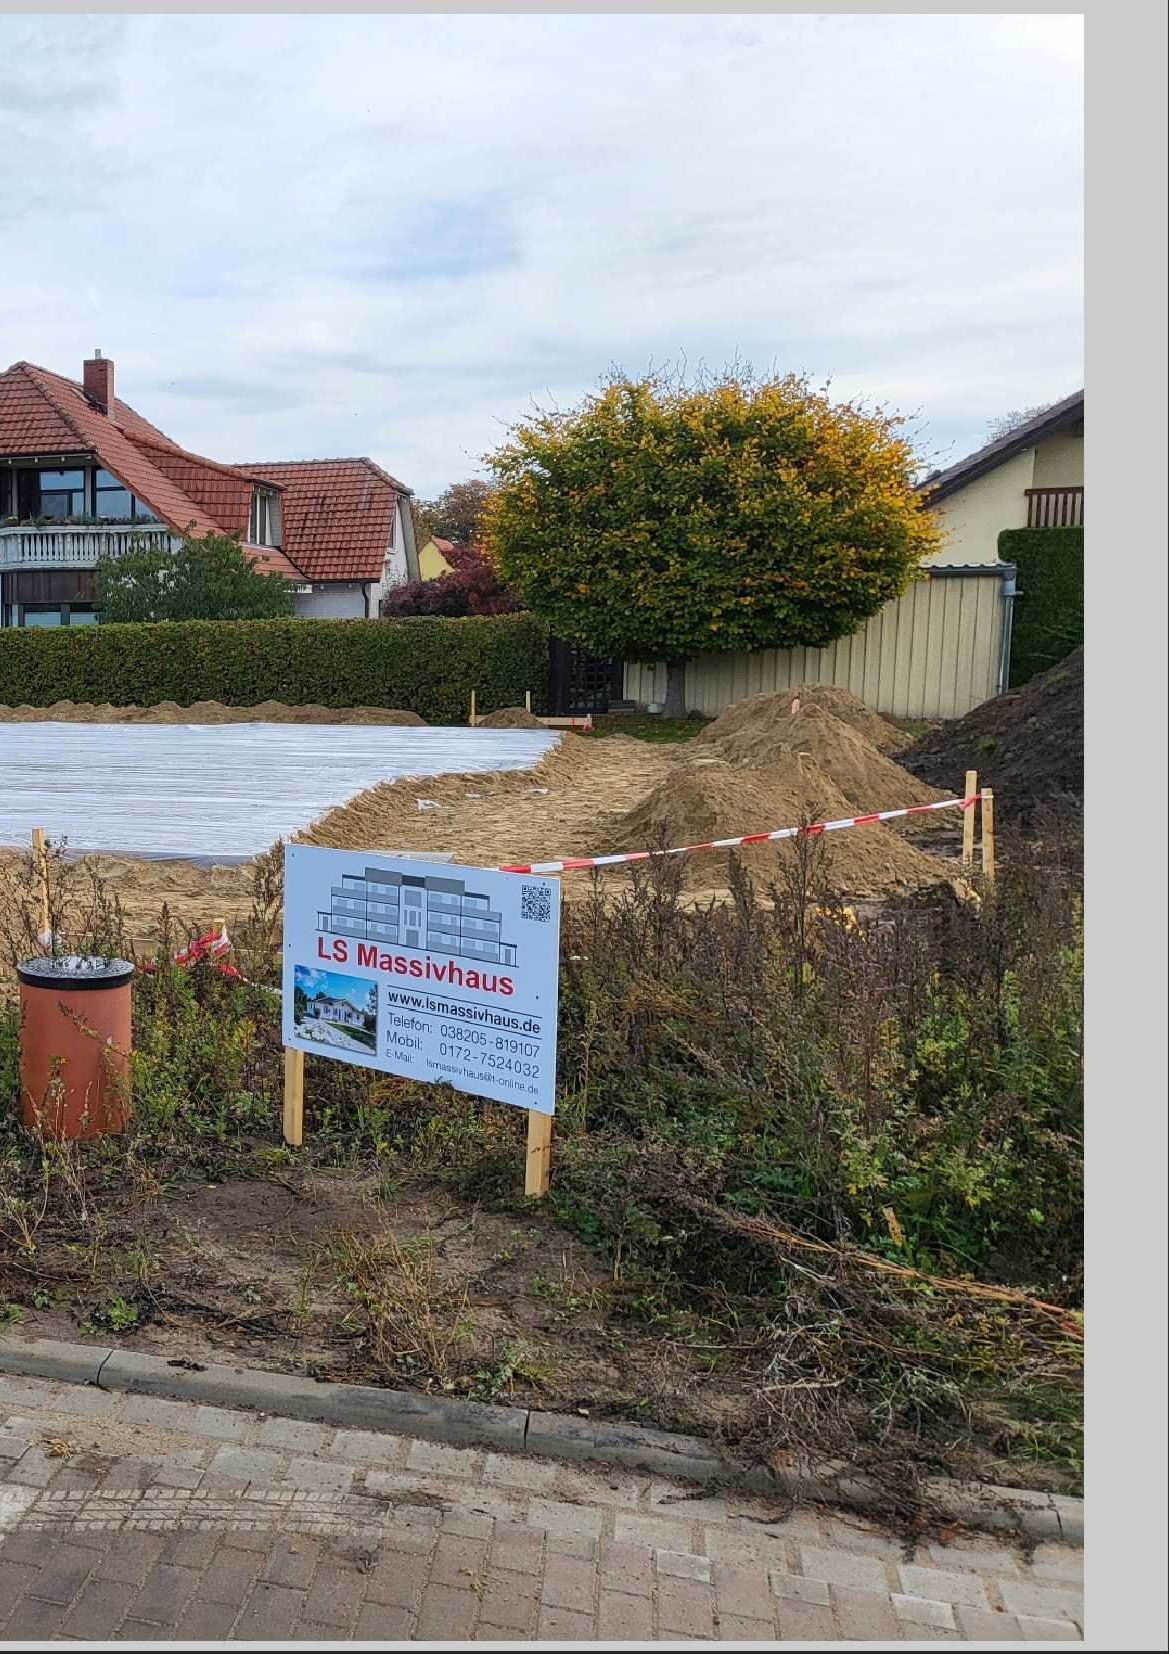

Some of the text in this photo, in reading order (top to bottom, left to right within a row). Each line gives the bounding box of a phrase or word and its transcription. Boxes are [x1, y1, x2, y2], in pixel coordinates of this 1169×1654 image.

[317, 936, 515, 996] LS Massivhaus
[387, 1012, 432, 1034] Telefon:
[388, 991, 541, 1034] www.lsmassivhaus.de
[386, 1030, 423, 1051] Mobil:
[386, 1048, 415, 1064] E-Mail:
